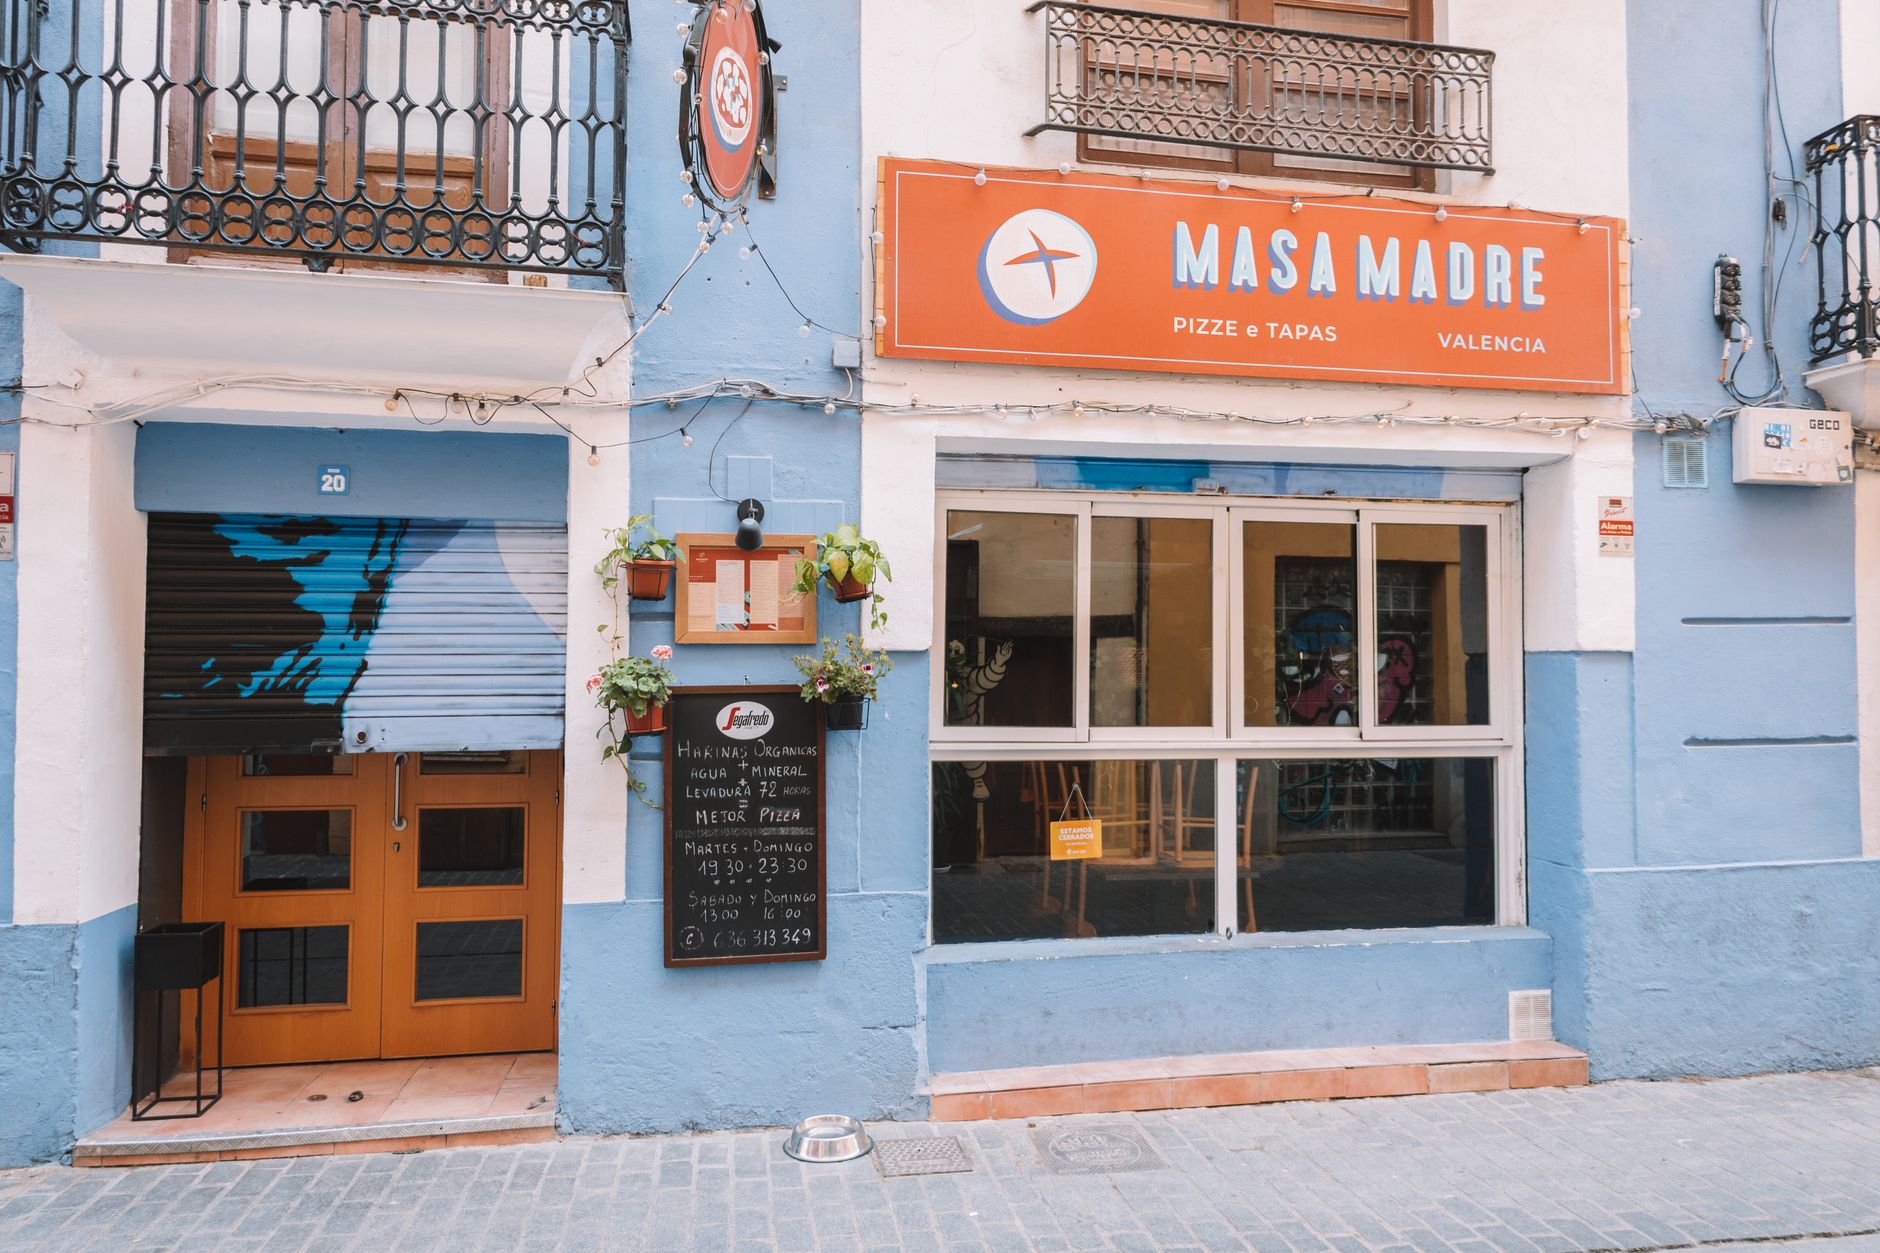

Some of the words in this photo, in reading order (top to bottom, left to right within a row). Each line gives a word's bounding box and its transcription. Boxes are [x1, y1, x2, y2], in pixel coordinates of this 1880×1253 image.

[1172, 221, 1337, 299] MASA
[1355, 234, 1547, 312] MADRE
[1173, 316, 1239, 337] PIZZE
[1246, 325, 1259, 338] e
[1266, 322, 1338, 342] TAPAS
[1437, 332, 1547, 354] VALENCIA
[321, 474, 346, 493] 20
[1600, 521, 1633, 531] Alarma
[722, 707, 770, 730] Segafredo
[677, 740, 748, 760] HARINAS
[754, 738, 818, 759] ORGANICAS
[690, 767, 728, 780] AGUA
[751, 764, 808, 778] MINERAL
[686, 785, 752, 799] LEVADURA
[759, 780, 778, 799] 72
[783, 785, 812, 796] HORAS
[760, 807, 801, 823] PIZZA
[1060, 827, 1092, 835] ESTAMOS
[685, 841, 738, 856] MARTES
[753, 839, 814, 854] DOMINGO
[689, 890, 742, 907] SABADO
[764, 889, 817, 904] DOMINGO
[781, 927, 812, 946] 349
